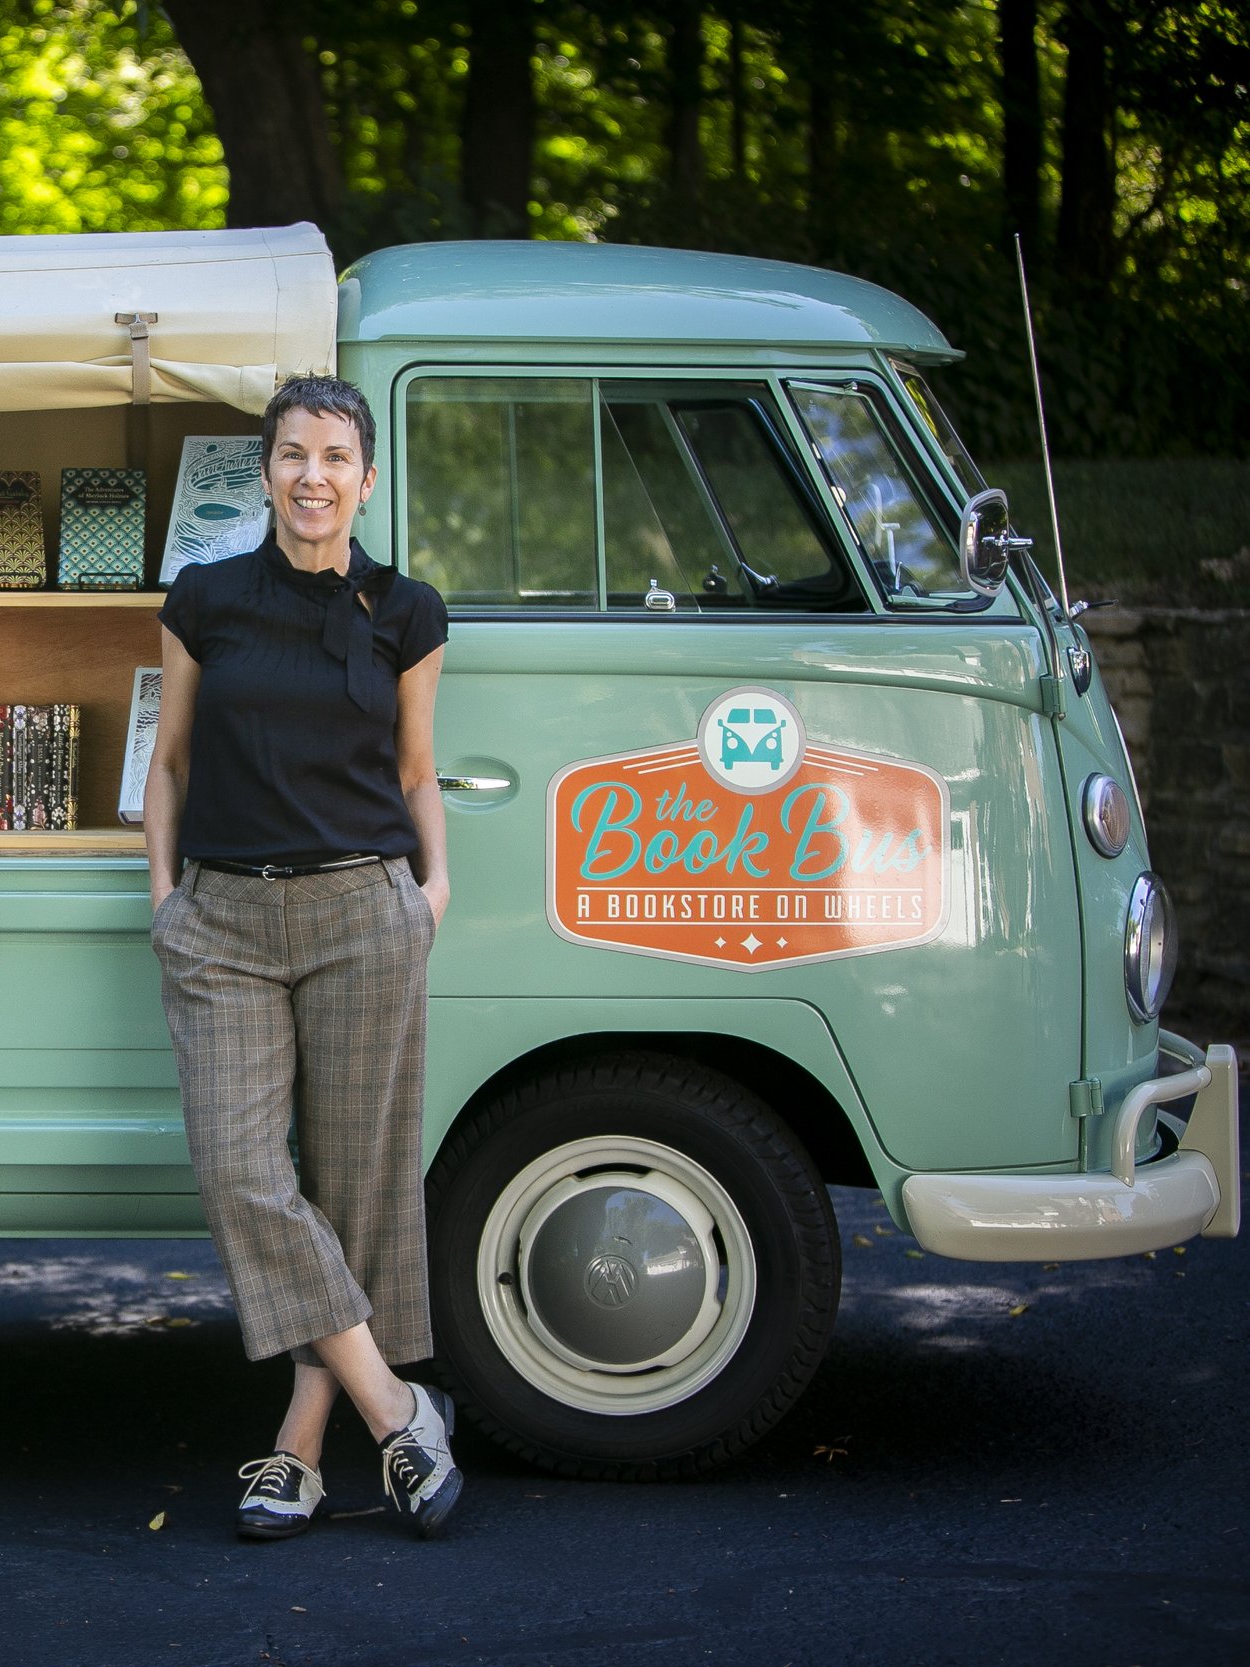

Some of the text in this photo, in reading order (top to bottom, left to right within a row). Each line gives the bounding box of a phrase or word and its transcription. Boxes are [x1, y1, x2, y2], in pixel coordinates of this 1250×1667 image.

[655, 782, 718, 822] the
[571, 781, 932, 882] Book Bus
[577, 894, 923, 919] A BOOKSTORE ON WHEELS
